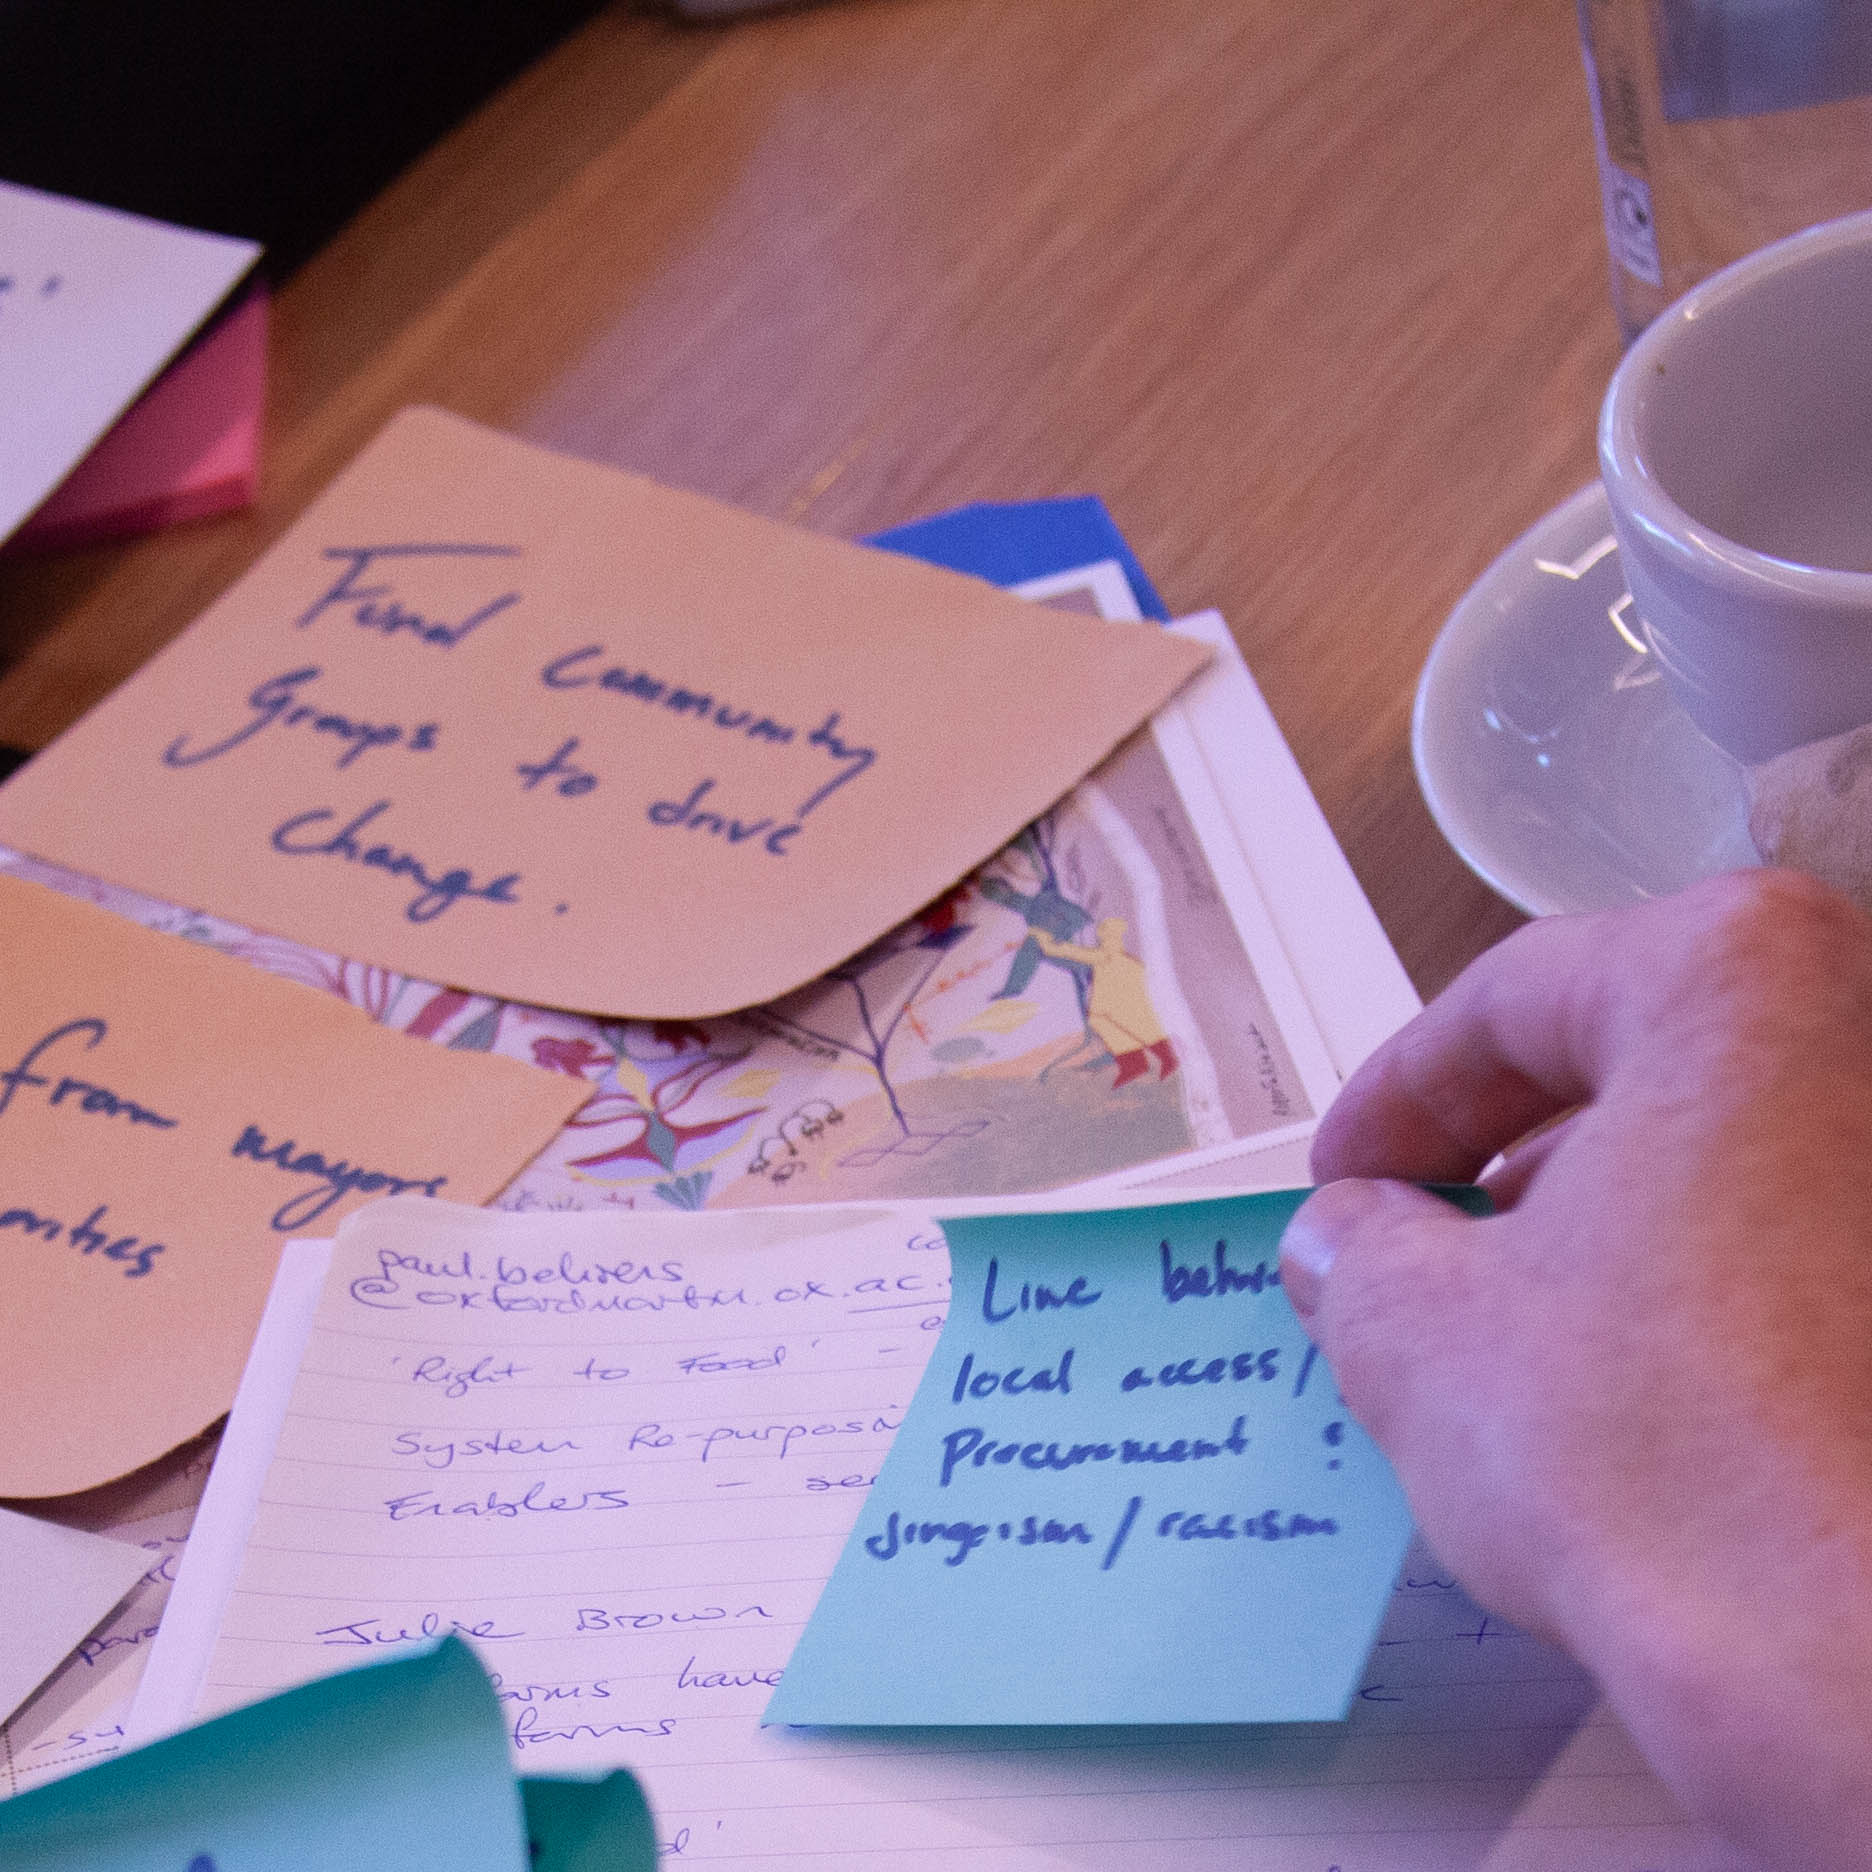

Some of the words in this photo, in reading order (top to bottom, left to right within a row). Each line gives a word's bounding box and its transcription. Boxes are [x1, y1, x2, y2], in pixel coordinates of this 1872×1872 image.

[297, 543, 523, 648] Fund
[518, 738, 599, 797] to
[648, 779, 804, 857] drive
[230, 1122, 449, 1232] mayors
[980, 1255, 1104, 1325] Line
[571, 1354, 631, 1383] to
[952, 1346, 1076, 1404] local
[390, 1429, 584, 1469] System
[626, 1402, 903, 1463] Re-purposi
[383, 1481, 631, 1522] Enablers
[575, 1605, 775, 1633] Brown
